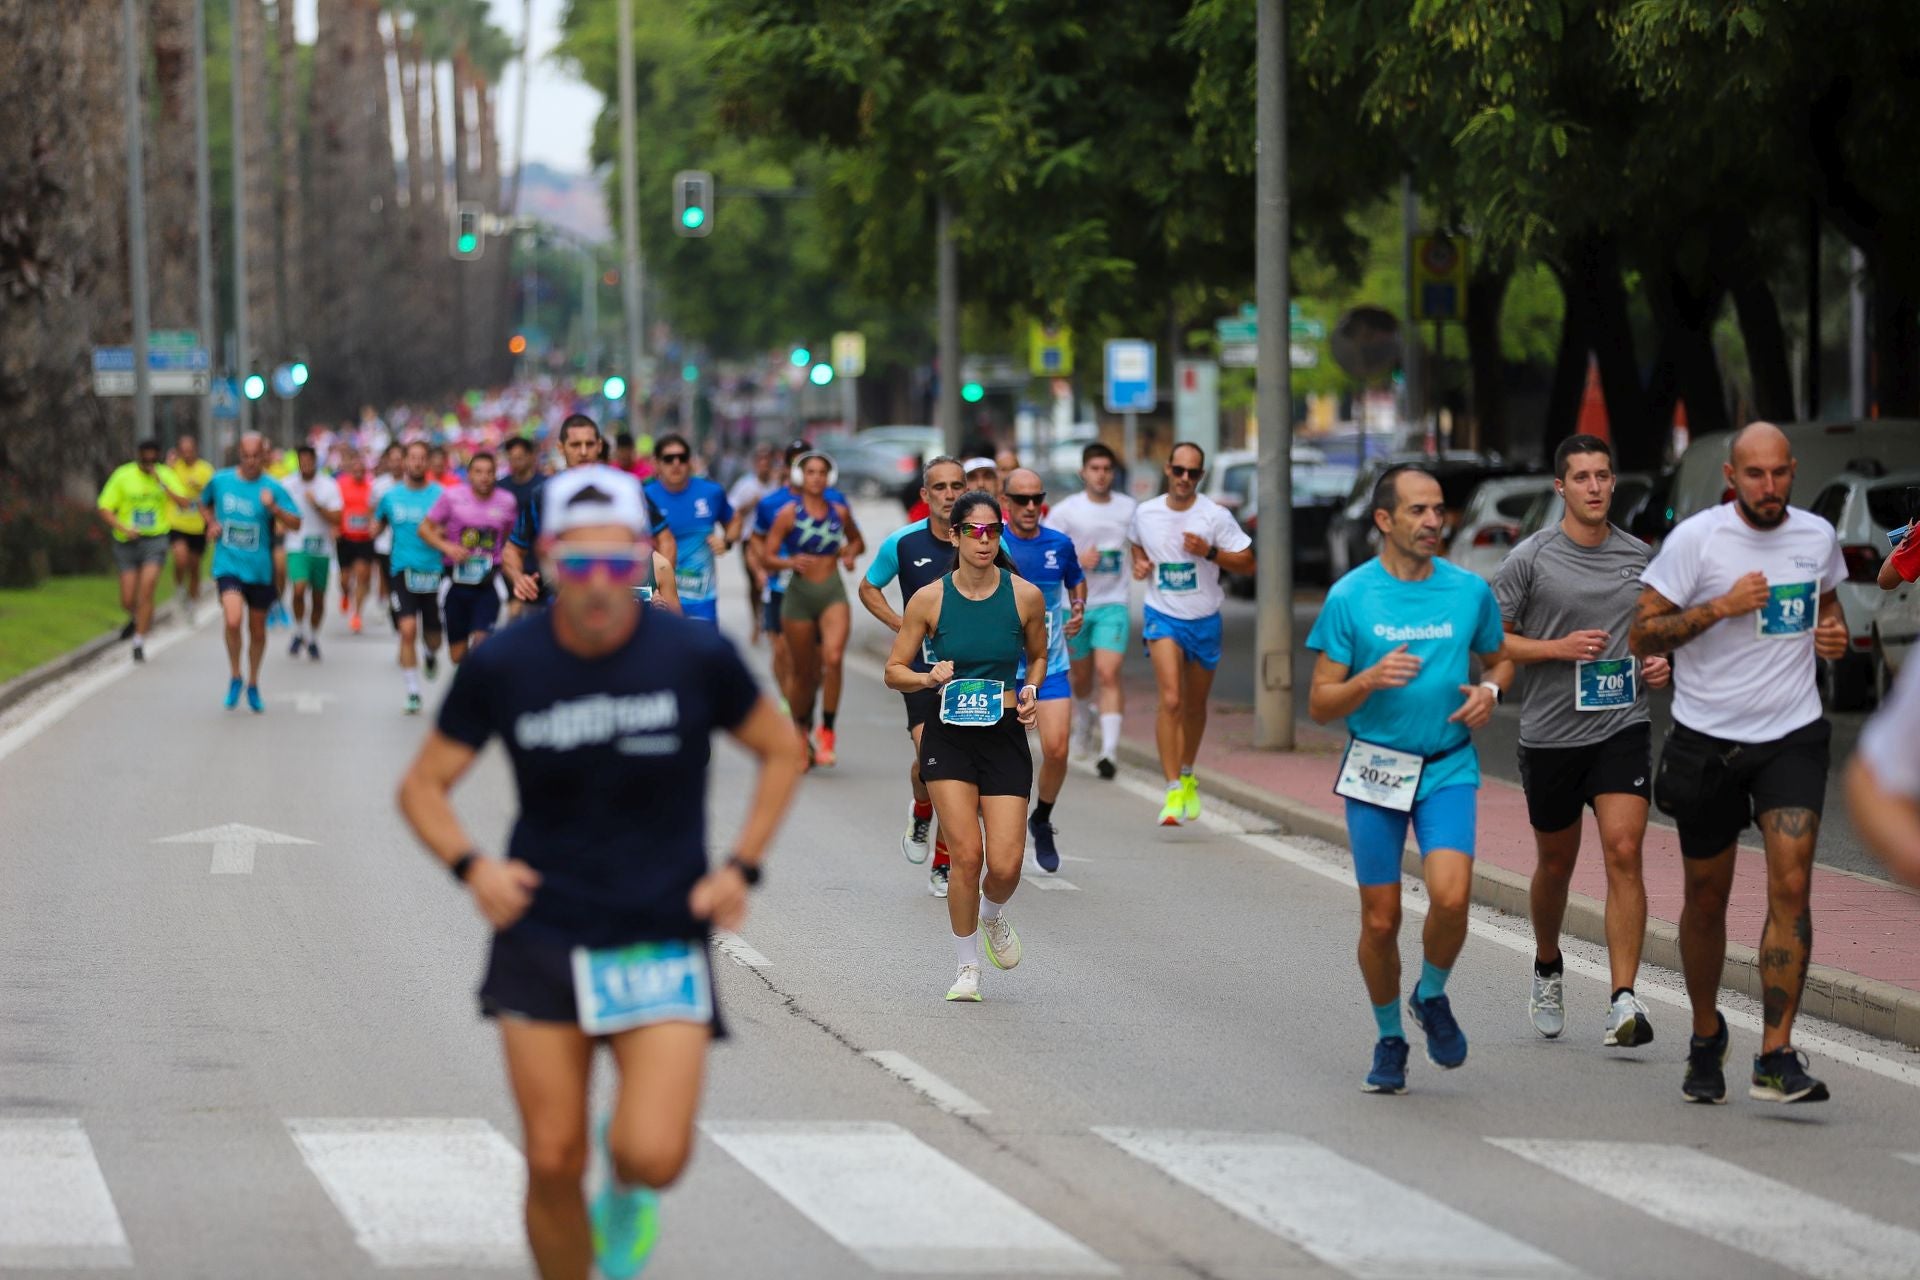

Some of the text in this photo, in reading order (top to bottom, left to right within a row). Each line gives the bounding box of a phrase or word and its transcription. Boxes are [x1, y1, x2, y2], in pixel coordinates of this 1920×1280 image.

[1779, 598, 1805, 617] 79
[1596, 673, 1624, 690] 706
[957, 693, 988, 708] 245
[1360, 766, 1402, 789] 2022
